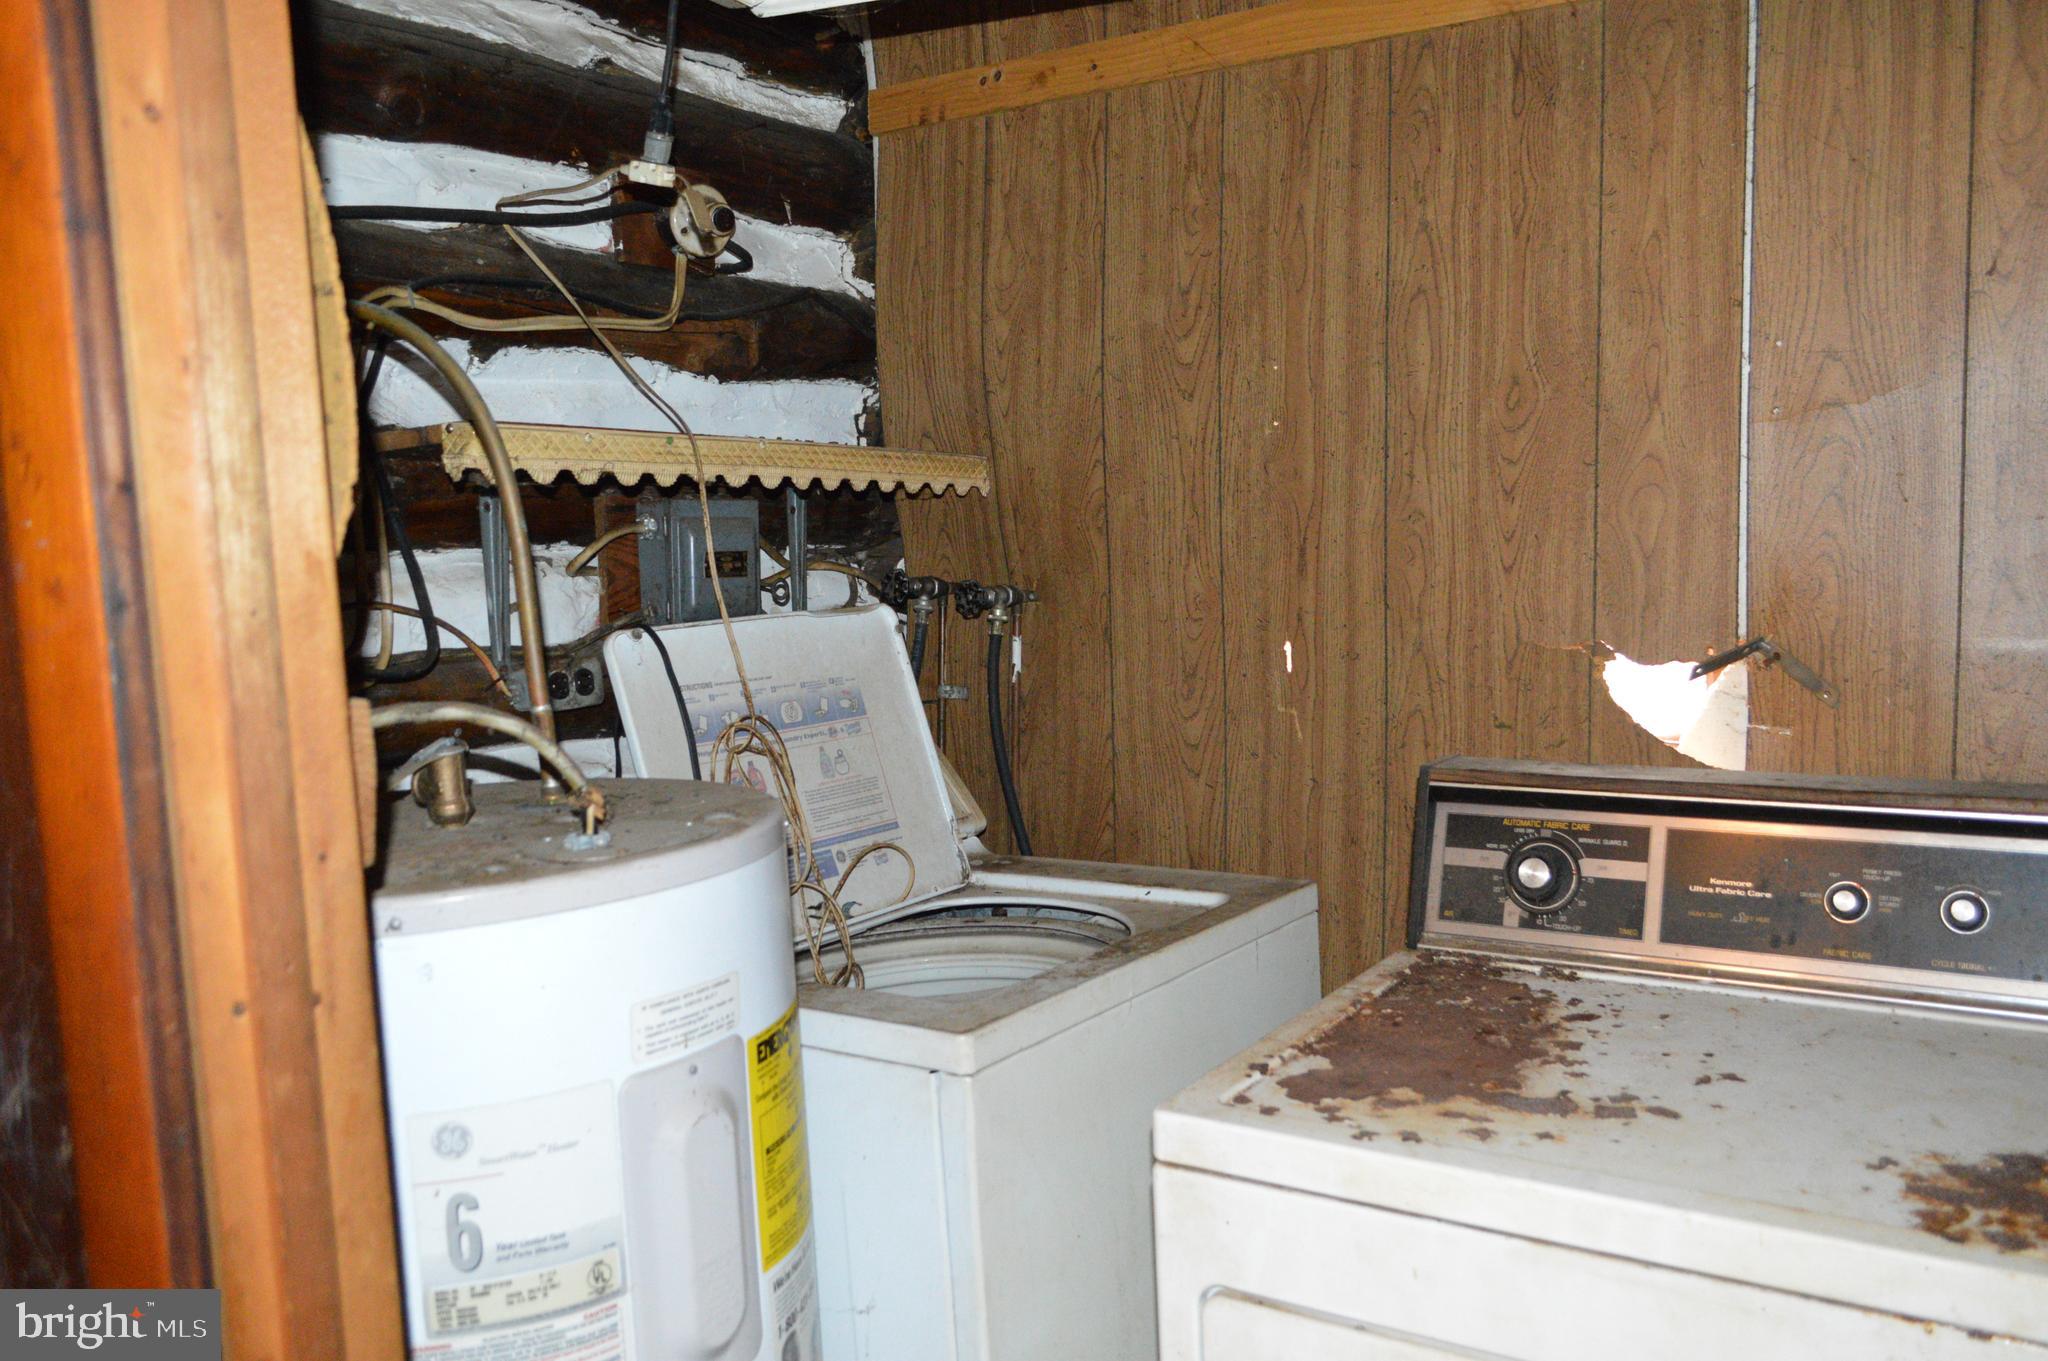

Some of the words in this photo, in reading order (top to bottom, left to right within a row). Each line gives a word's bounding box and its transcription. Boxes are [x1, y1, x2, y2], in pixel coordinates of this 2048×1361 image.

[1502, 818, 1541, 829] AUTOMATIC
[1543, 821, 1569, 831] FABRIC
[1571, 823, 1592, 832] CARE
[1709, 877, 1752, 887] Kenmore
[1689, 885, 1713, 894] Ultra
[1714, 887, 1745, 898] Fabric
[1746, 890, 1773, 899] Care
[1852, 951, 1872, 960] CARE
[1931, 959, 1955, 969] CYCLE
[446, 1192, 484, 1273] 6
